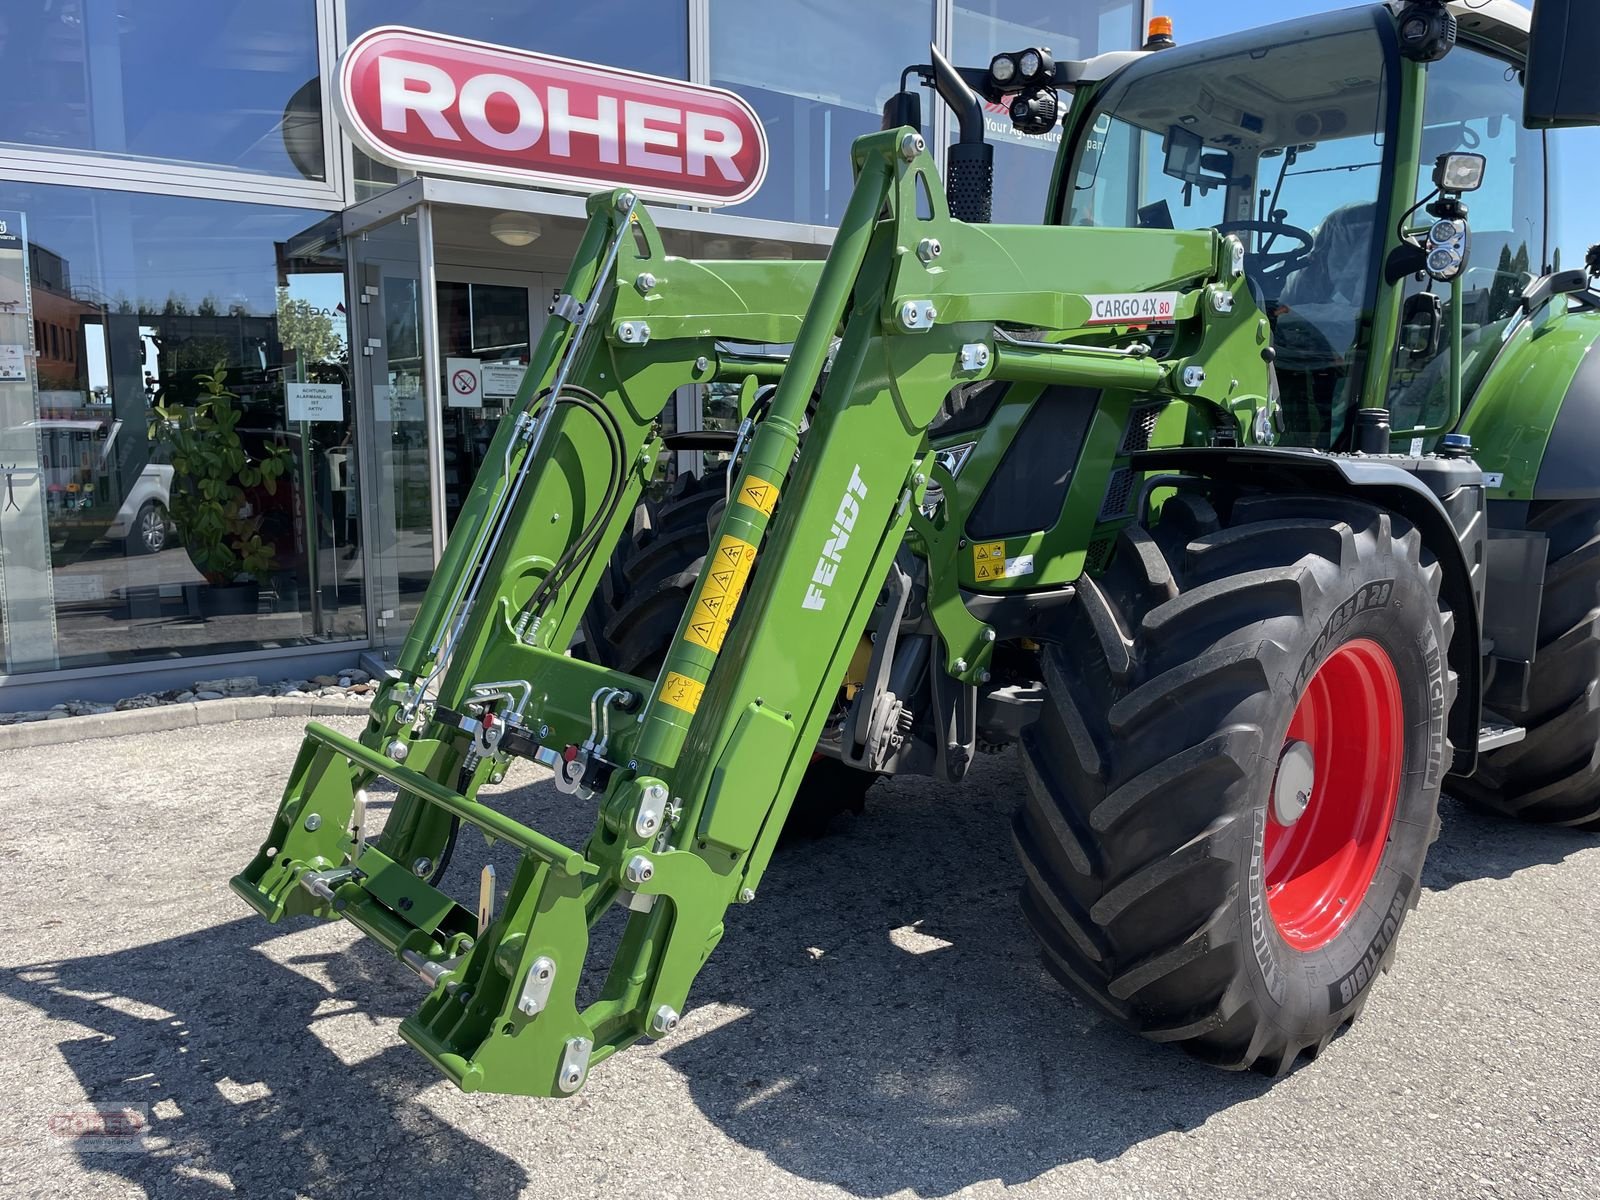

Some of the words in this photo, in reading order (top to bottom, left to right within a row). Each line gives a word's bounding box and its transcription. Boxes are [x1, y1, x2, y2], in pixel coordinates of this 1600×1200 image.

[378, 55, 745, 183] ROHER
[985, 117, 1007, 133] Your
[1096, 299, 1140, 318] CARGO
[1142, 298, 1157, 315] 4X
[1159, 301, 1170, 314] 80
[801, 463, 868, 611] FENDT
[1425, 647, 1444, 787] MICHELIN
[1250, 810, 1275, 976] MICHELIN
[1340, 891, 1408, 1004] MULTIBIB
